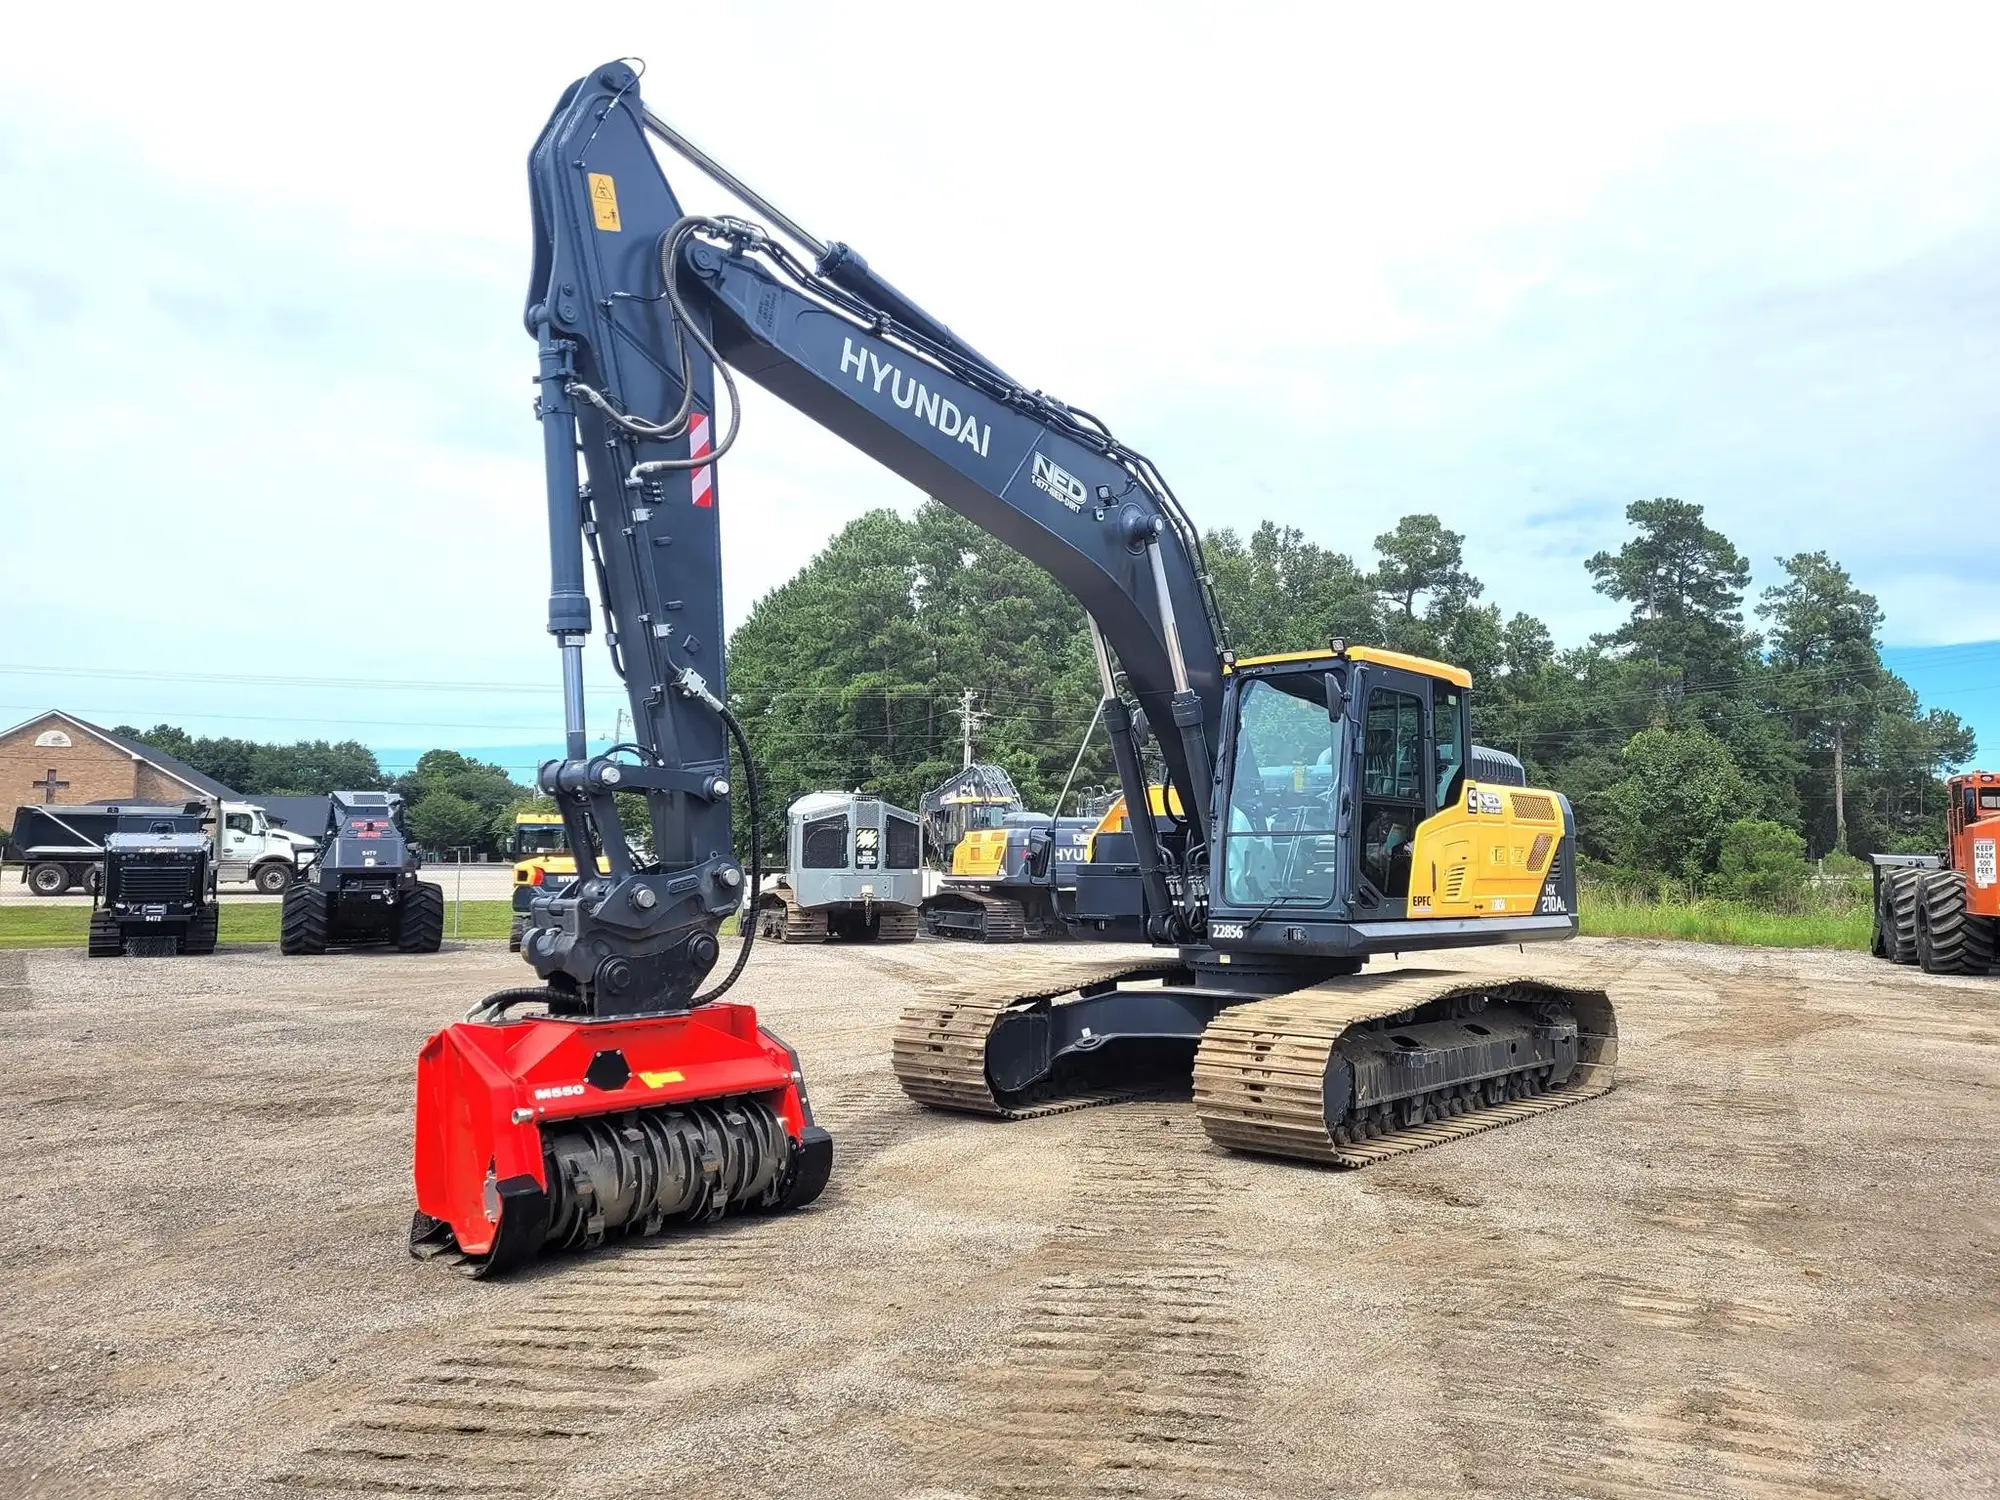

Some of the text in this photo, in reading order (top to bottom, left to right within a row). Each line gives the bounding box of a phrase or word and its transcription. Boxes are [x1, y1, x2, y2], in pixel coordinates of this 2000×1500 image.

[840, 337, 992, 458] HYUNDAI
[1032, 451, 1087, 505] NED
[1545, 884, 1556, 895] HX
[1413, 896, 1431, 906] EPFC
[1212, 924, 1243, 939] 22856
[534, 1084, 585, 1100] M550
